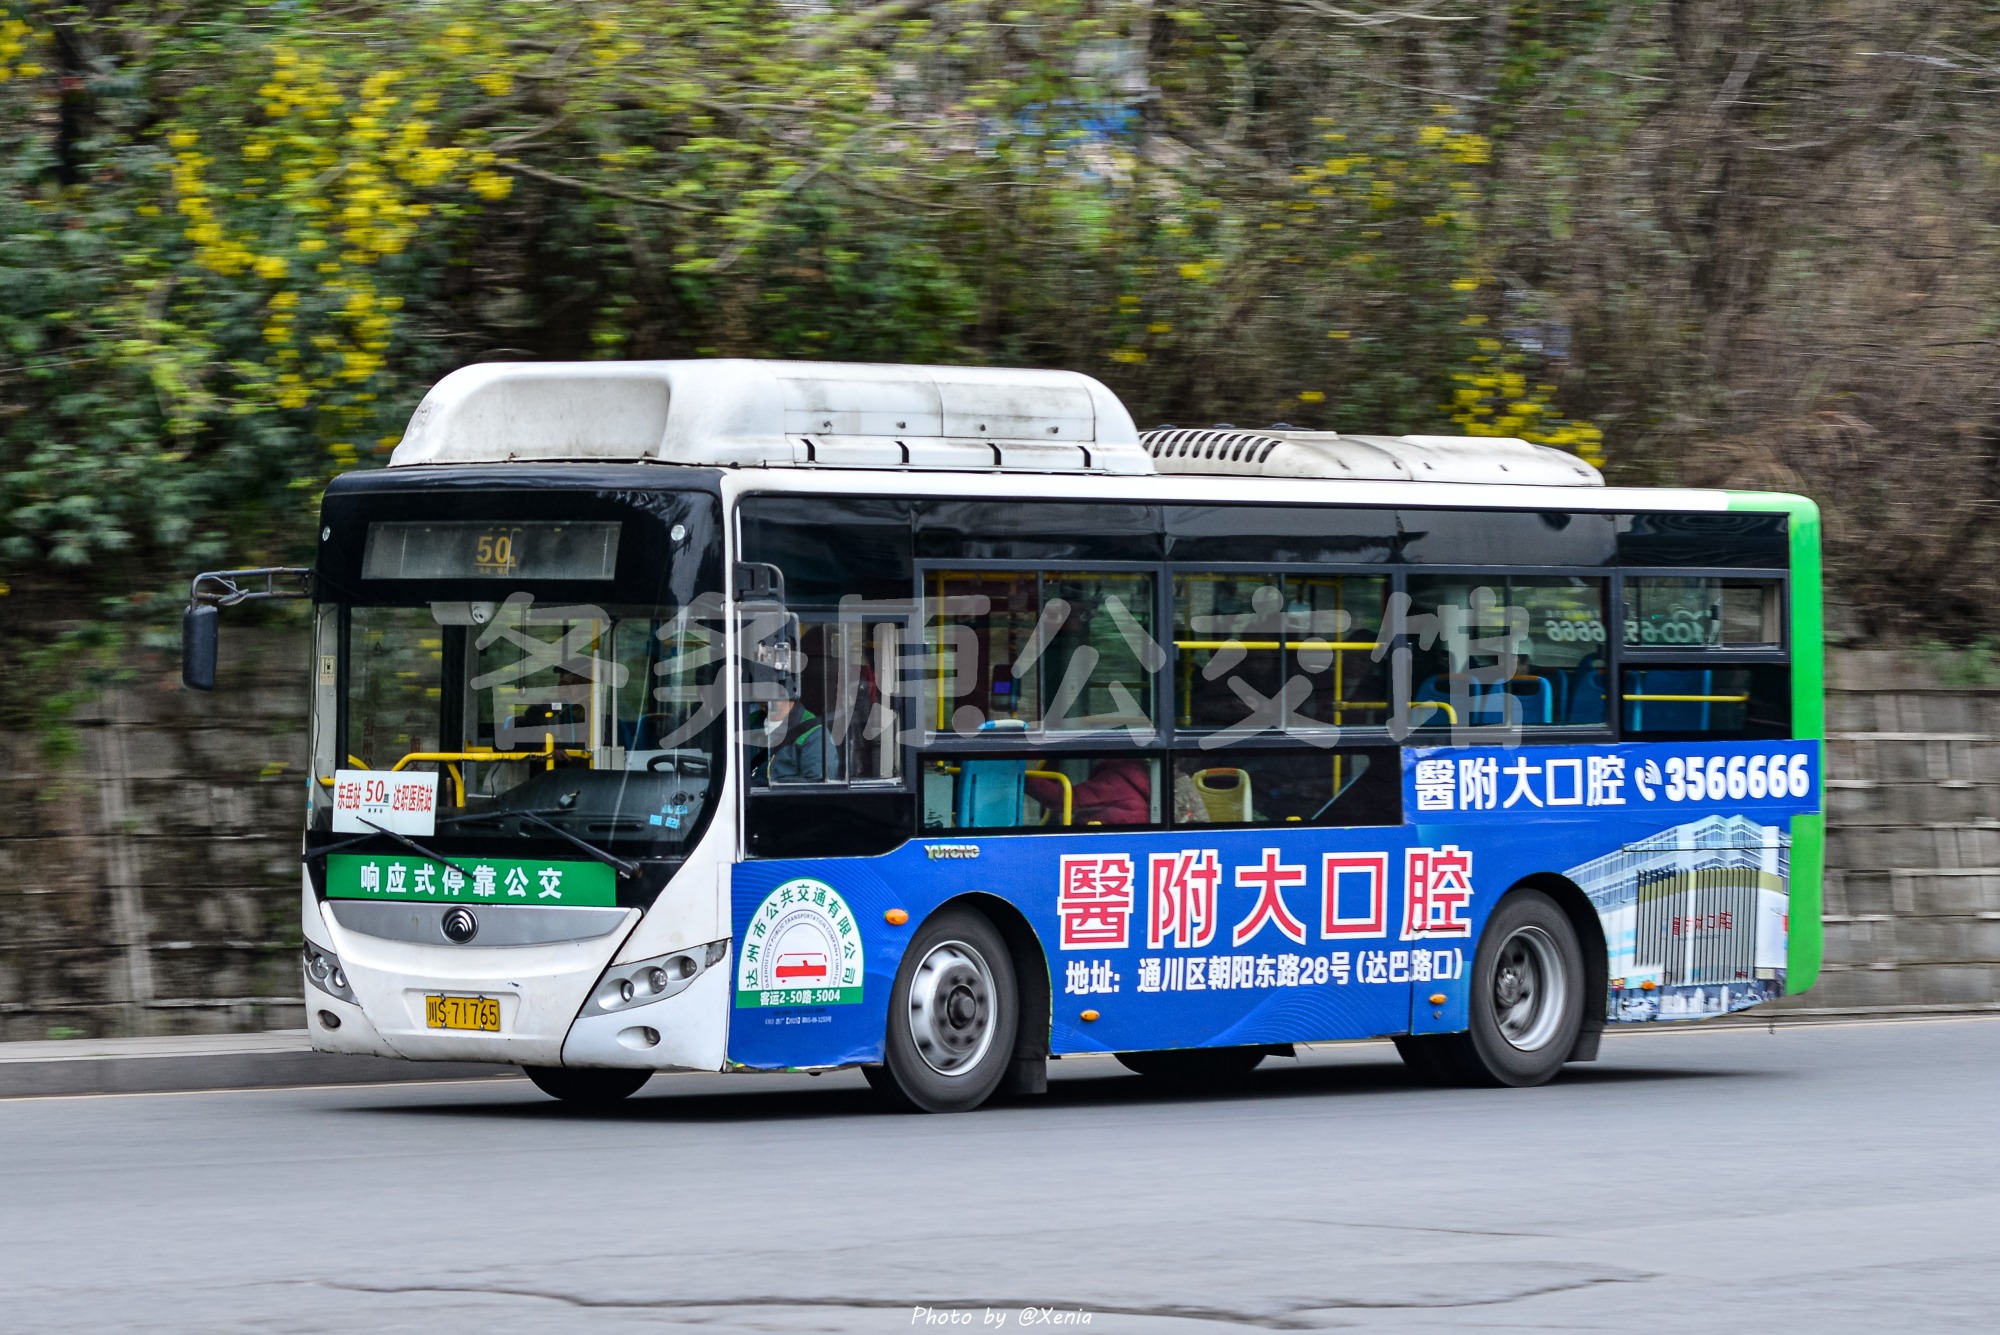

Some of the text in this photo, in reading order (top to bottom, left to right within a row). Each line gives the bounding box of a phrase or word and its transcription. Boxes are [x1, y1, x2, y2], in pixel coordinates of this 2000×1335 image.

[476, 536, 516, 564] 50
[337, 782, 361, 810] 东岳站
[1415, 753, 1811, 811] 醫附大口腔 3566666
[360, 861, 563, 899] 响应式停靠公交
[1057, 845, 1474, 951] 醫附大口腔
[746, 884, 856, 989] 达州市公共交通有限公司
[771, 923, 785, 942] PUBLIC
[784, 913, 826, 928] TRANSPORTATION
[825, 926, 839, 957] COMPANY
[760, 989, 840, 1006] 客运2-50路-5004
